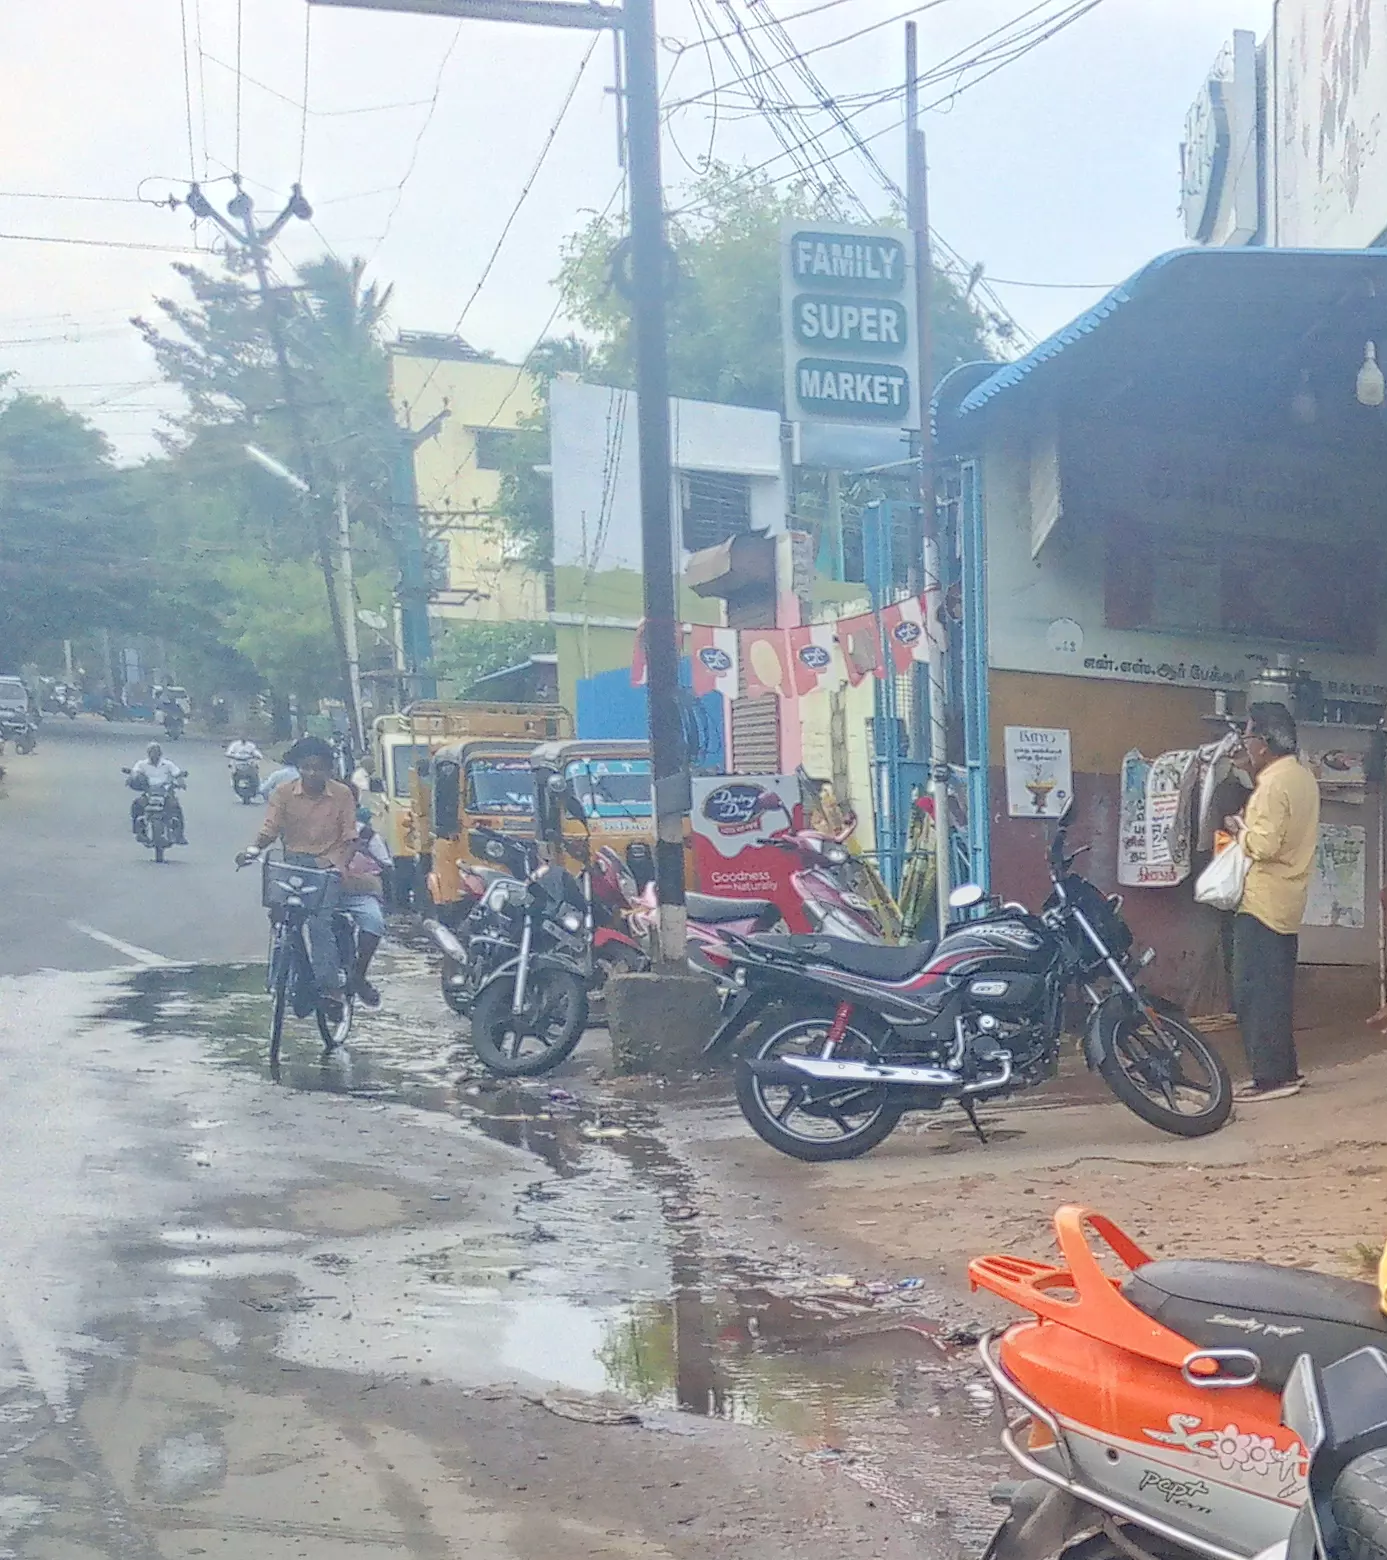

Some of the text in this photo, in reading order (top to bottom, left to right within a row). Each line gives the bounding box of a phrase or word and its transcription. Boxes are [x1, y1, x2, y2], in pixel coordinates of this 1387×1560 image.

[797, 241, 898, 279] FAMILY
[801, 302, 899, 343] SUPER
[801, 369, 904, 406] MARKET
[713, 789, 757, 808] Dairy
[719, 803, 753, 821] Day
[711, 871, 770, 882] Goodness
